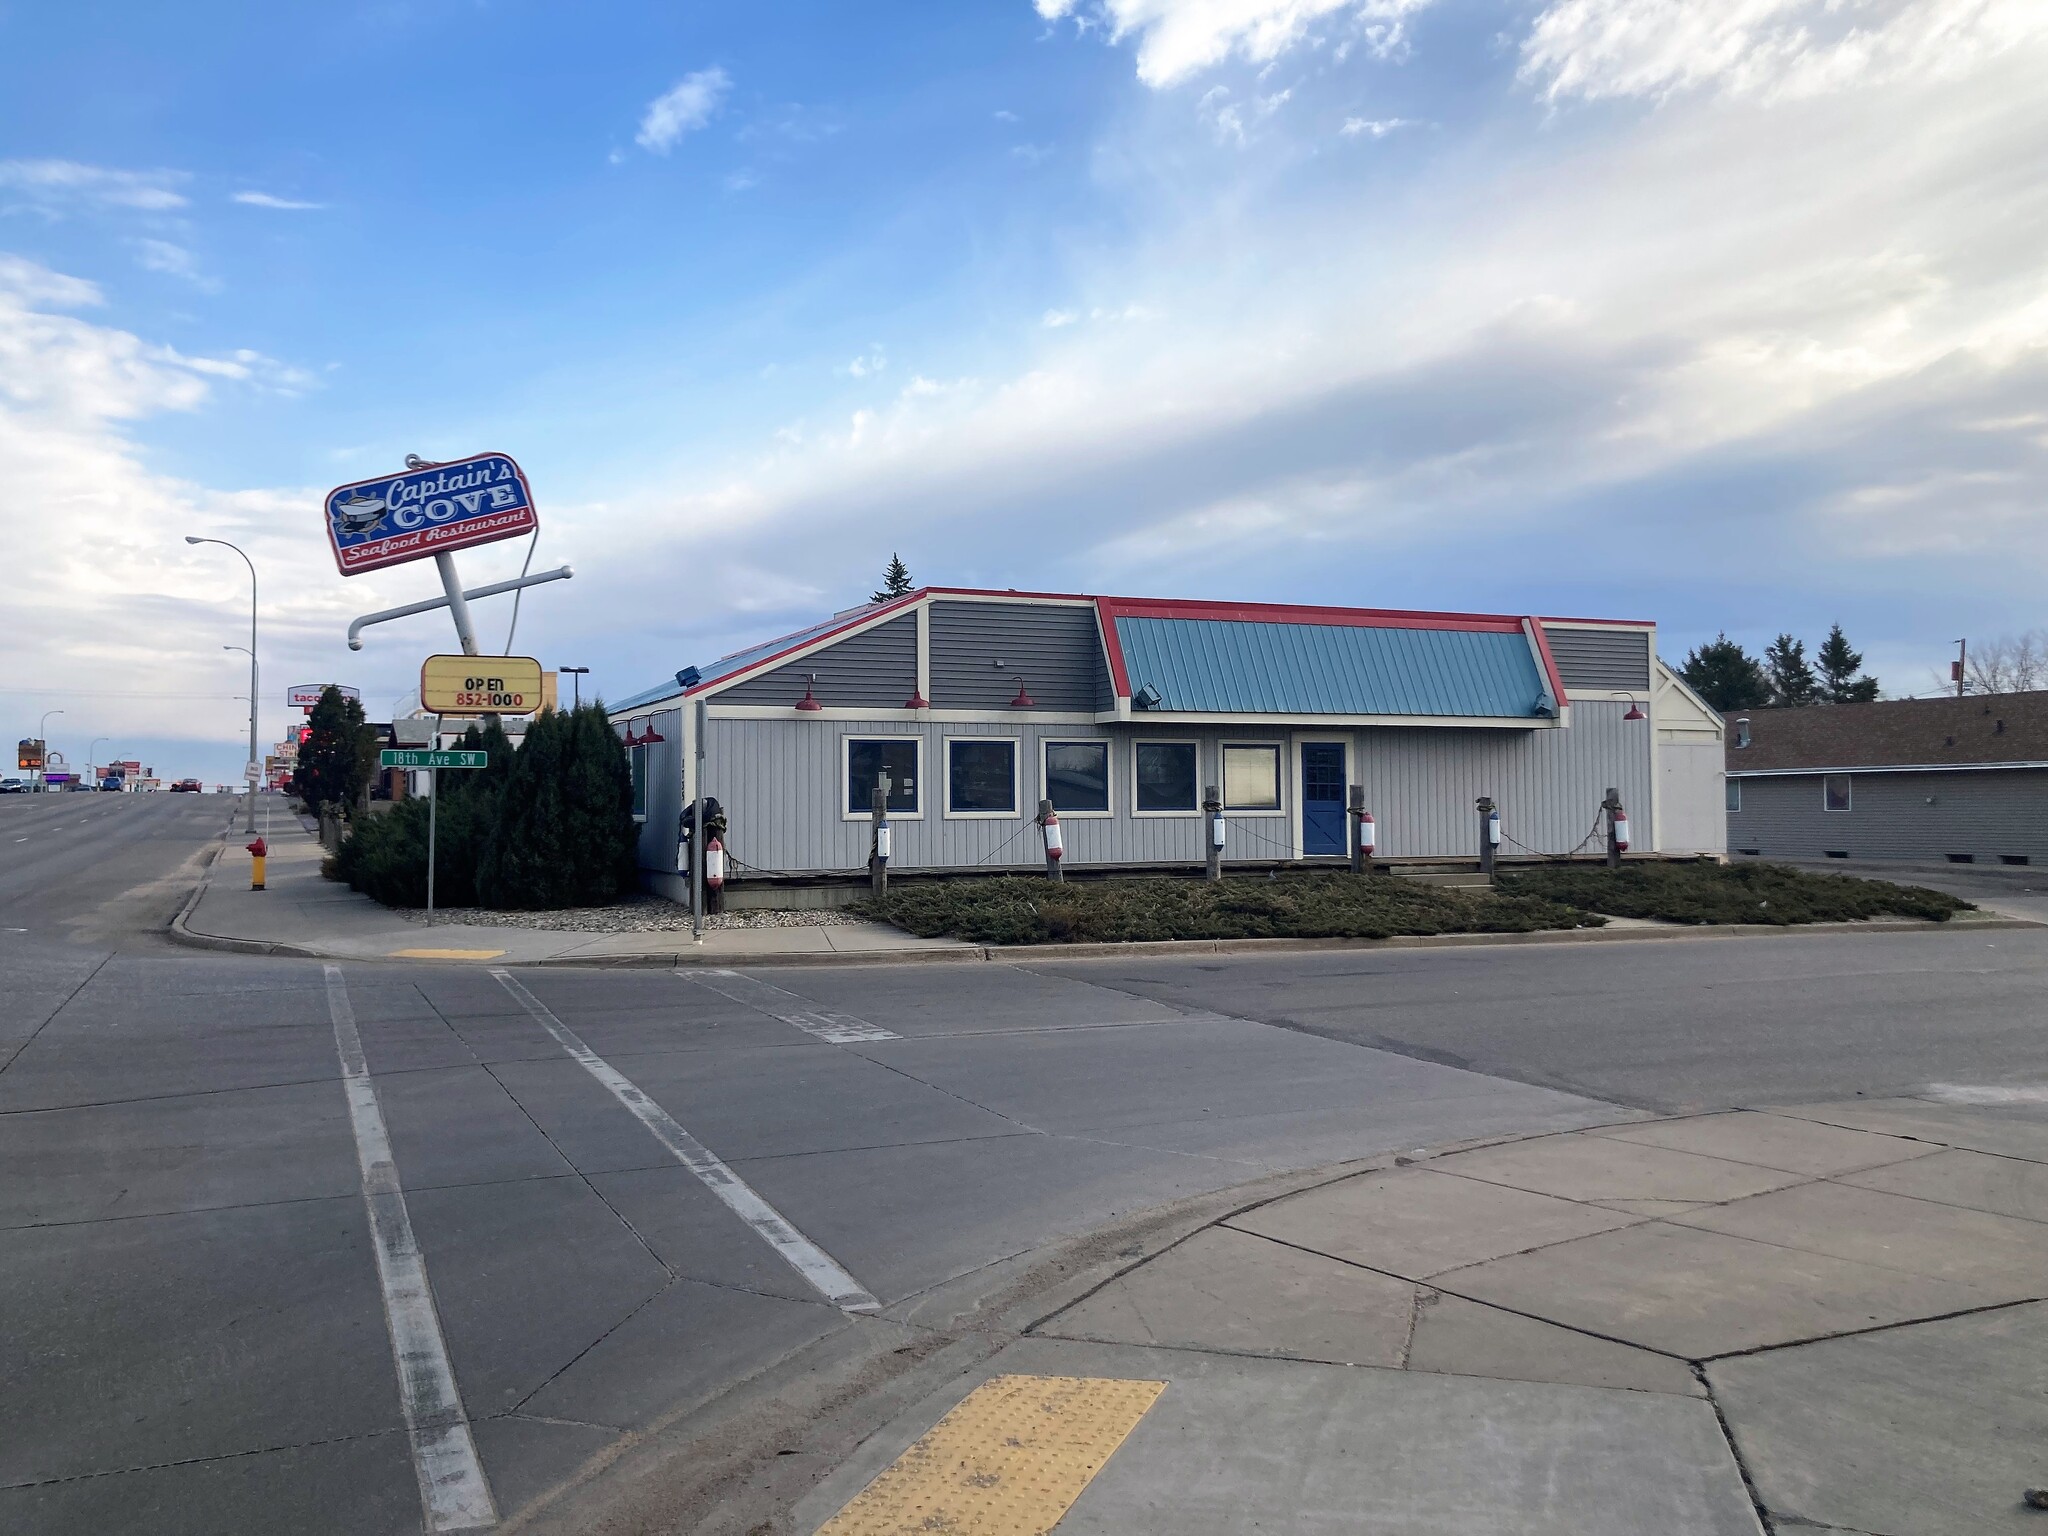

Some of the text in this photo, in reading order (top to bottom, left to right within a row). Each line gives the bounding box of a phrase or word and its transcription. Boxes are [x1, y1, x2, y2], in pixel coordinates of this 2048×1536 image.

[386, 460, 513, 510] Captain's
[393, 483, 519, 528] COVE
[346, 510, 527, 561] Seafood Restaurant
[456, 692, 524, 706] 852-1000
[464, 678, 504, 691] OPEN
[393, 752, 476, 766] 18th Ave SW
